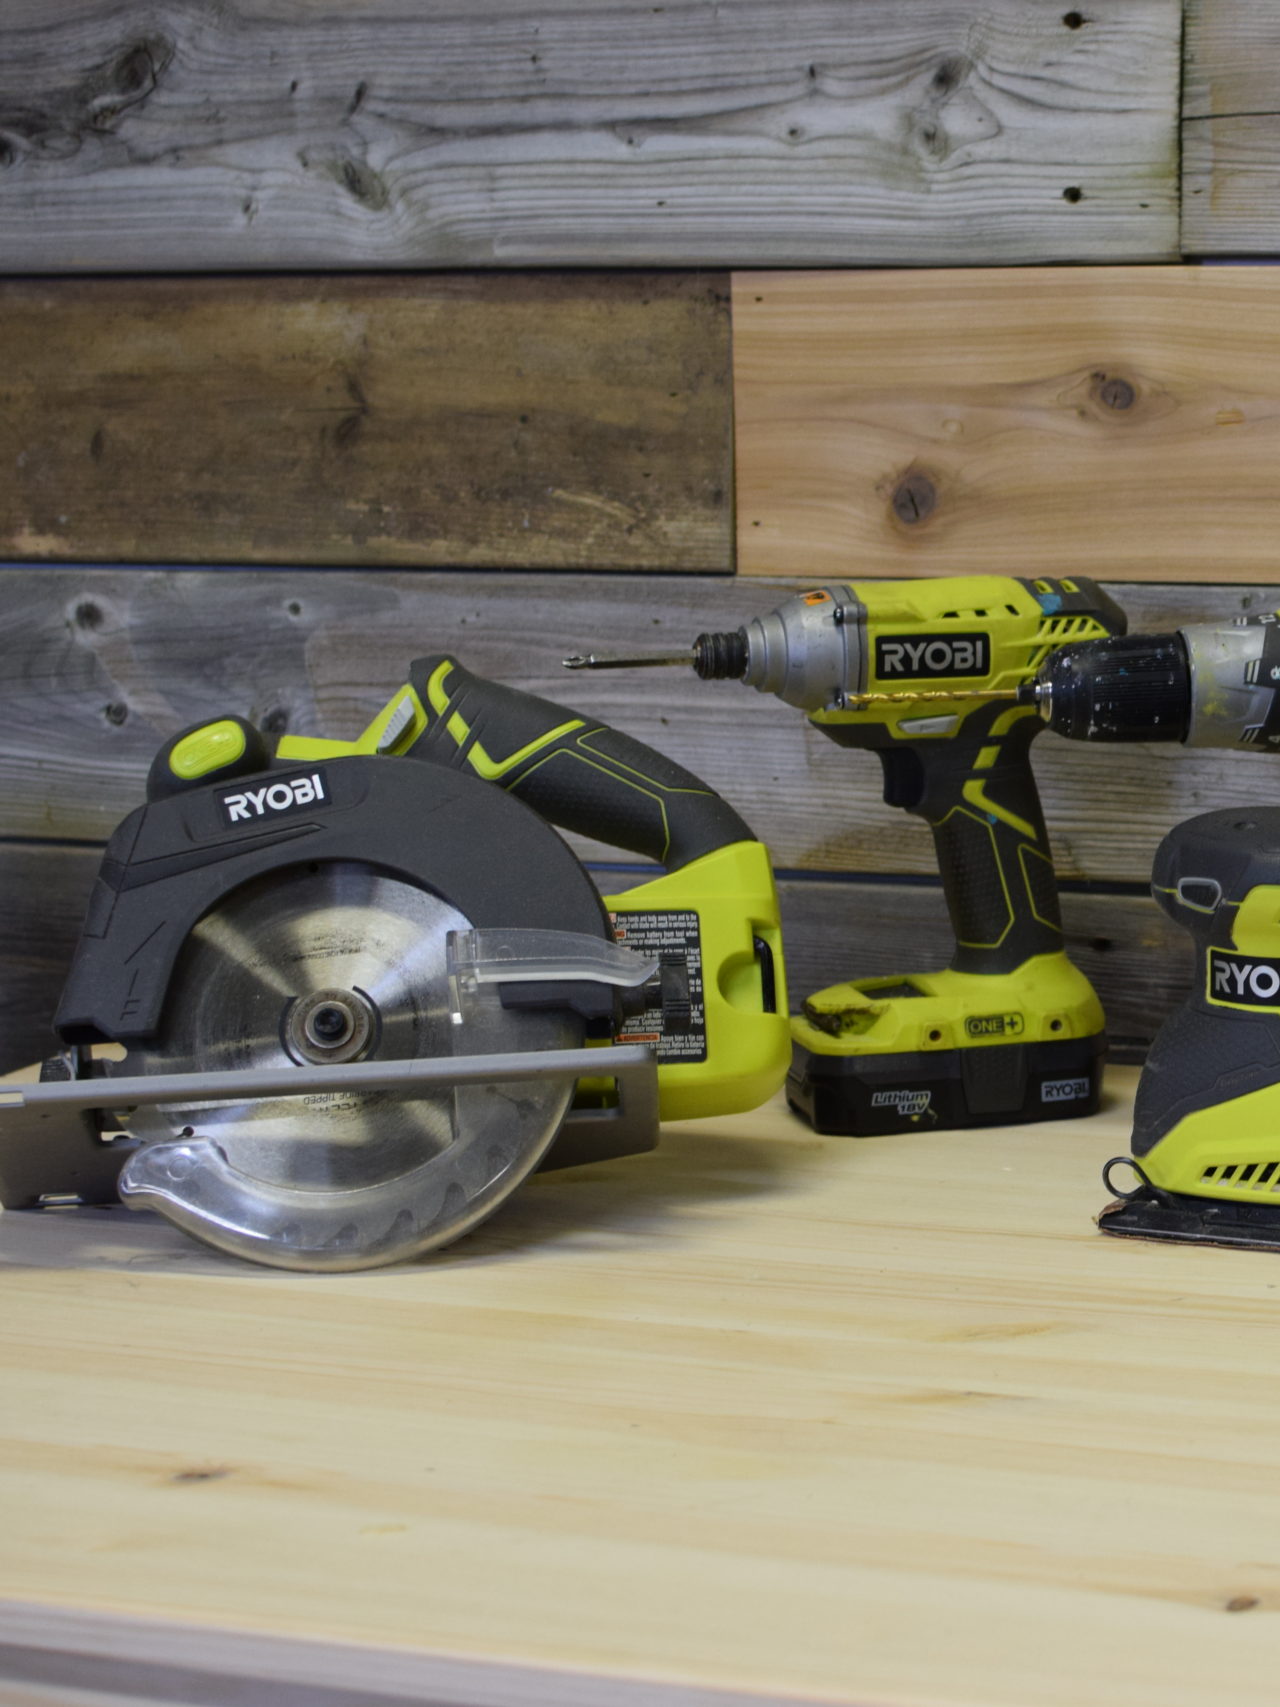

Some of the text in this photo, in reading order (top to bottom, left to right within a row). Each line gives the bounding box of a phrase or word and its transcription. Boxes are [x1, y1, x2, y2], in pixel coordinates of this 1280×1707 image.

[881, 640, 983, 672] RYOBI
[224, 774, 324, 822] RYOBI
[872, 1090, 931, 1107] Lithium
[1044, 1079, 1087, 1099] RYOBI
[899, 1102, 928, 1115] 18V
